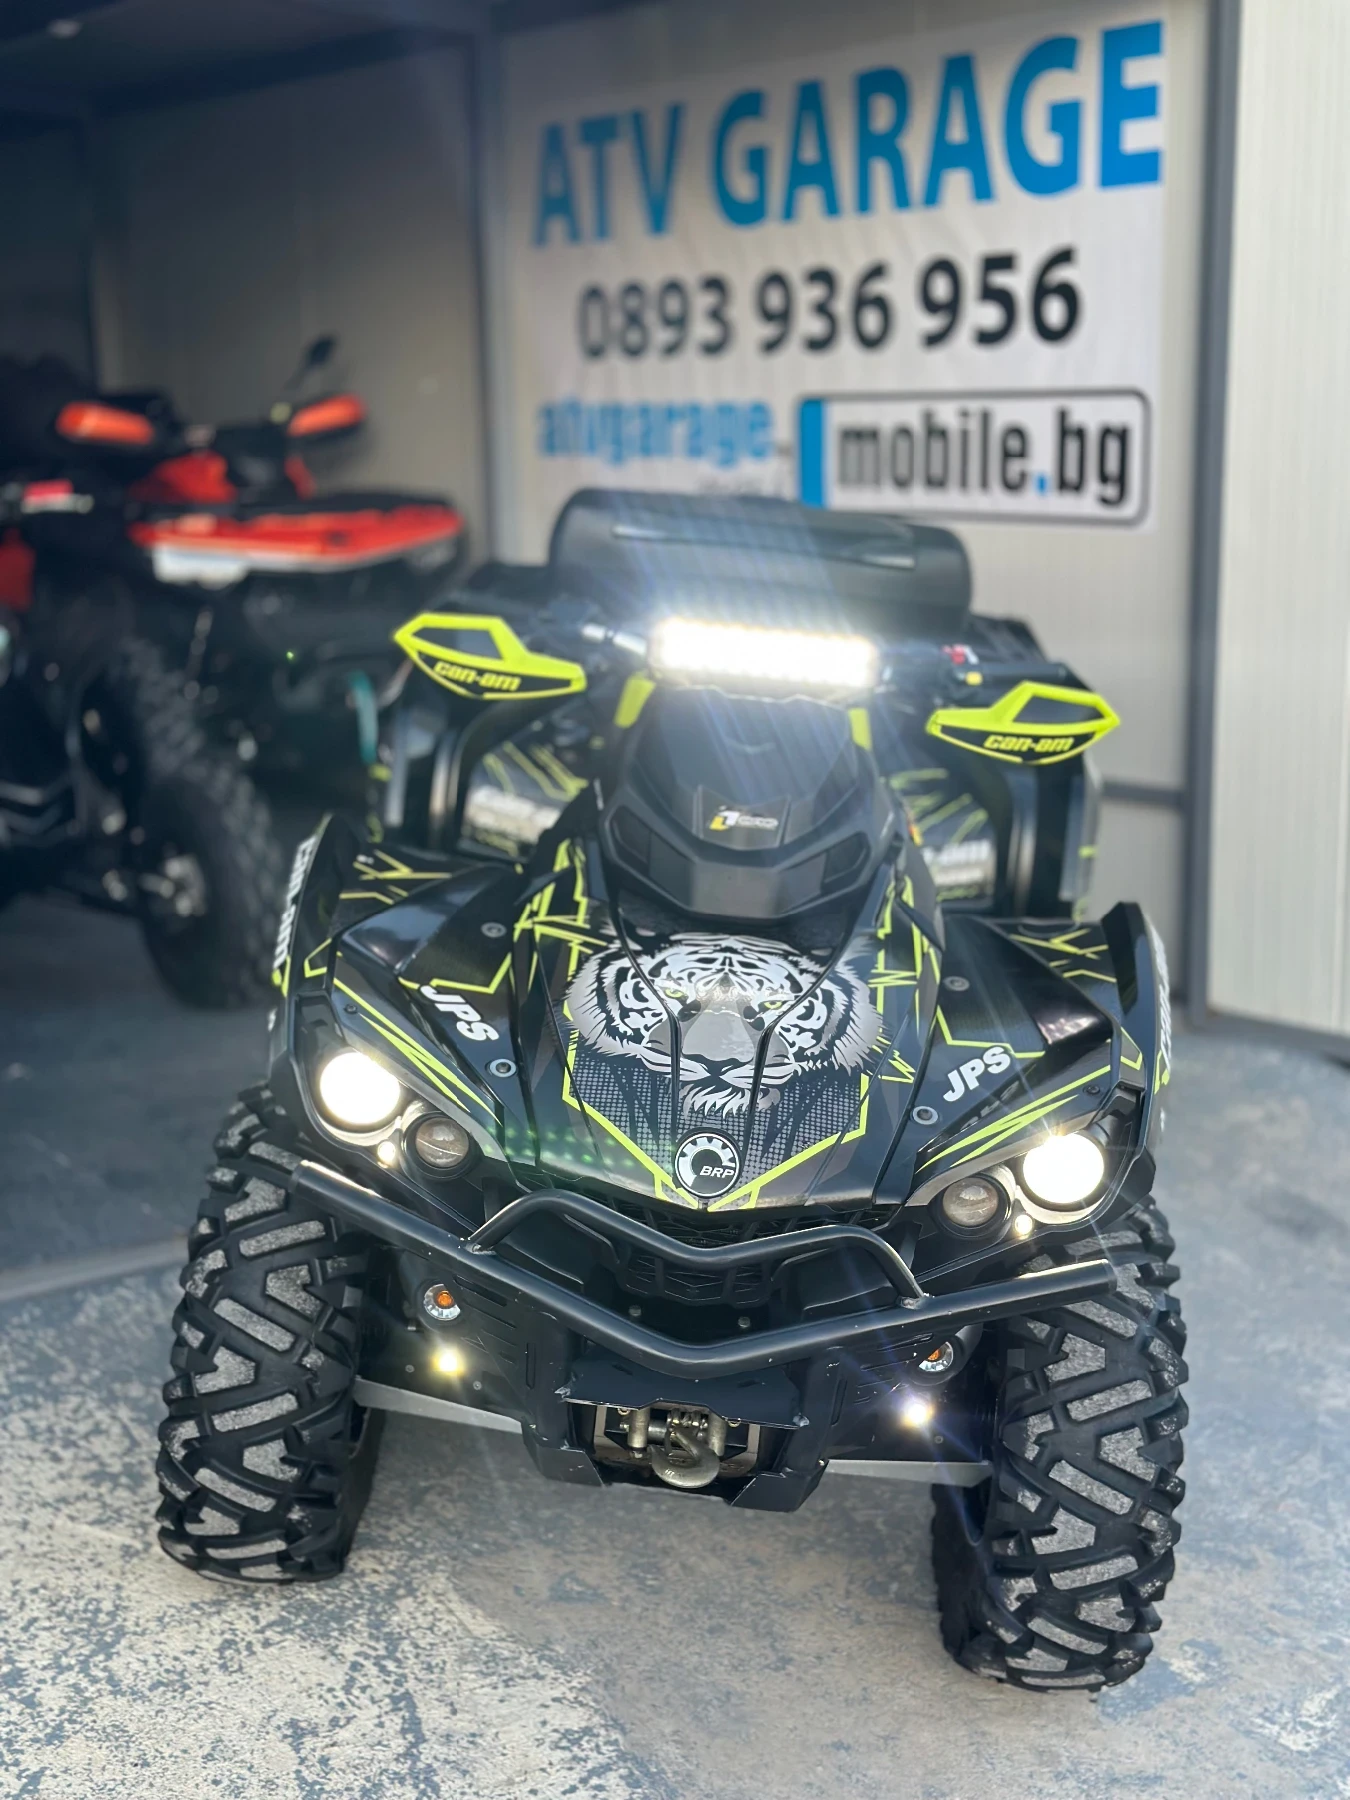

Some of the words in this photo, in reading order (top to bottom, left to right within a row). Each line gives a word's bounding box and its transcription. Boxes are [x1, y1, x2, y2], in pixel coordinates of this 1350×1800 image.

[533, 101, 684, 248] ATV
[710, 19, 1164, 230] GARAGE
[577, 273, 735, 363] 0893
[755, 262, 894, 354] 936
[917, 246, 1083, 350] 956
[834, 406, 1132, 508] mobile.bg
[433, 660, 522, 692] can-am
[983, 734, 1075, 753] can-am
[420, 985, 500, 1041] JPS
[943, 1046, 1011, 1102] JPS
[699, 1165, 735, 1179] BRP
